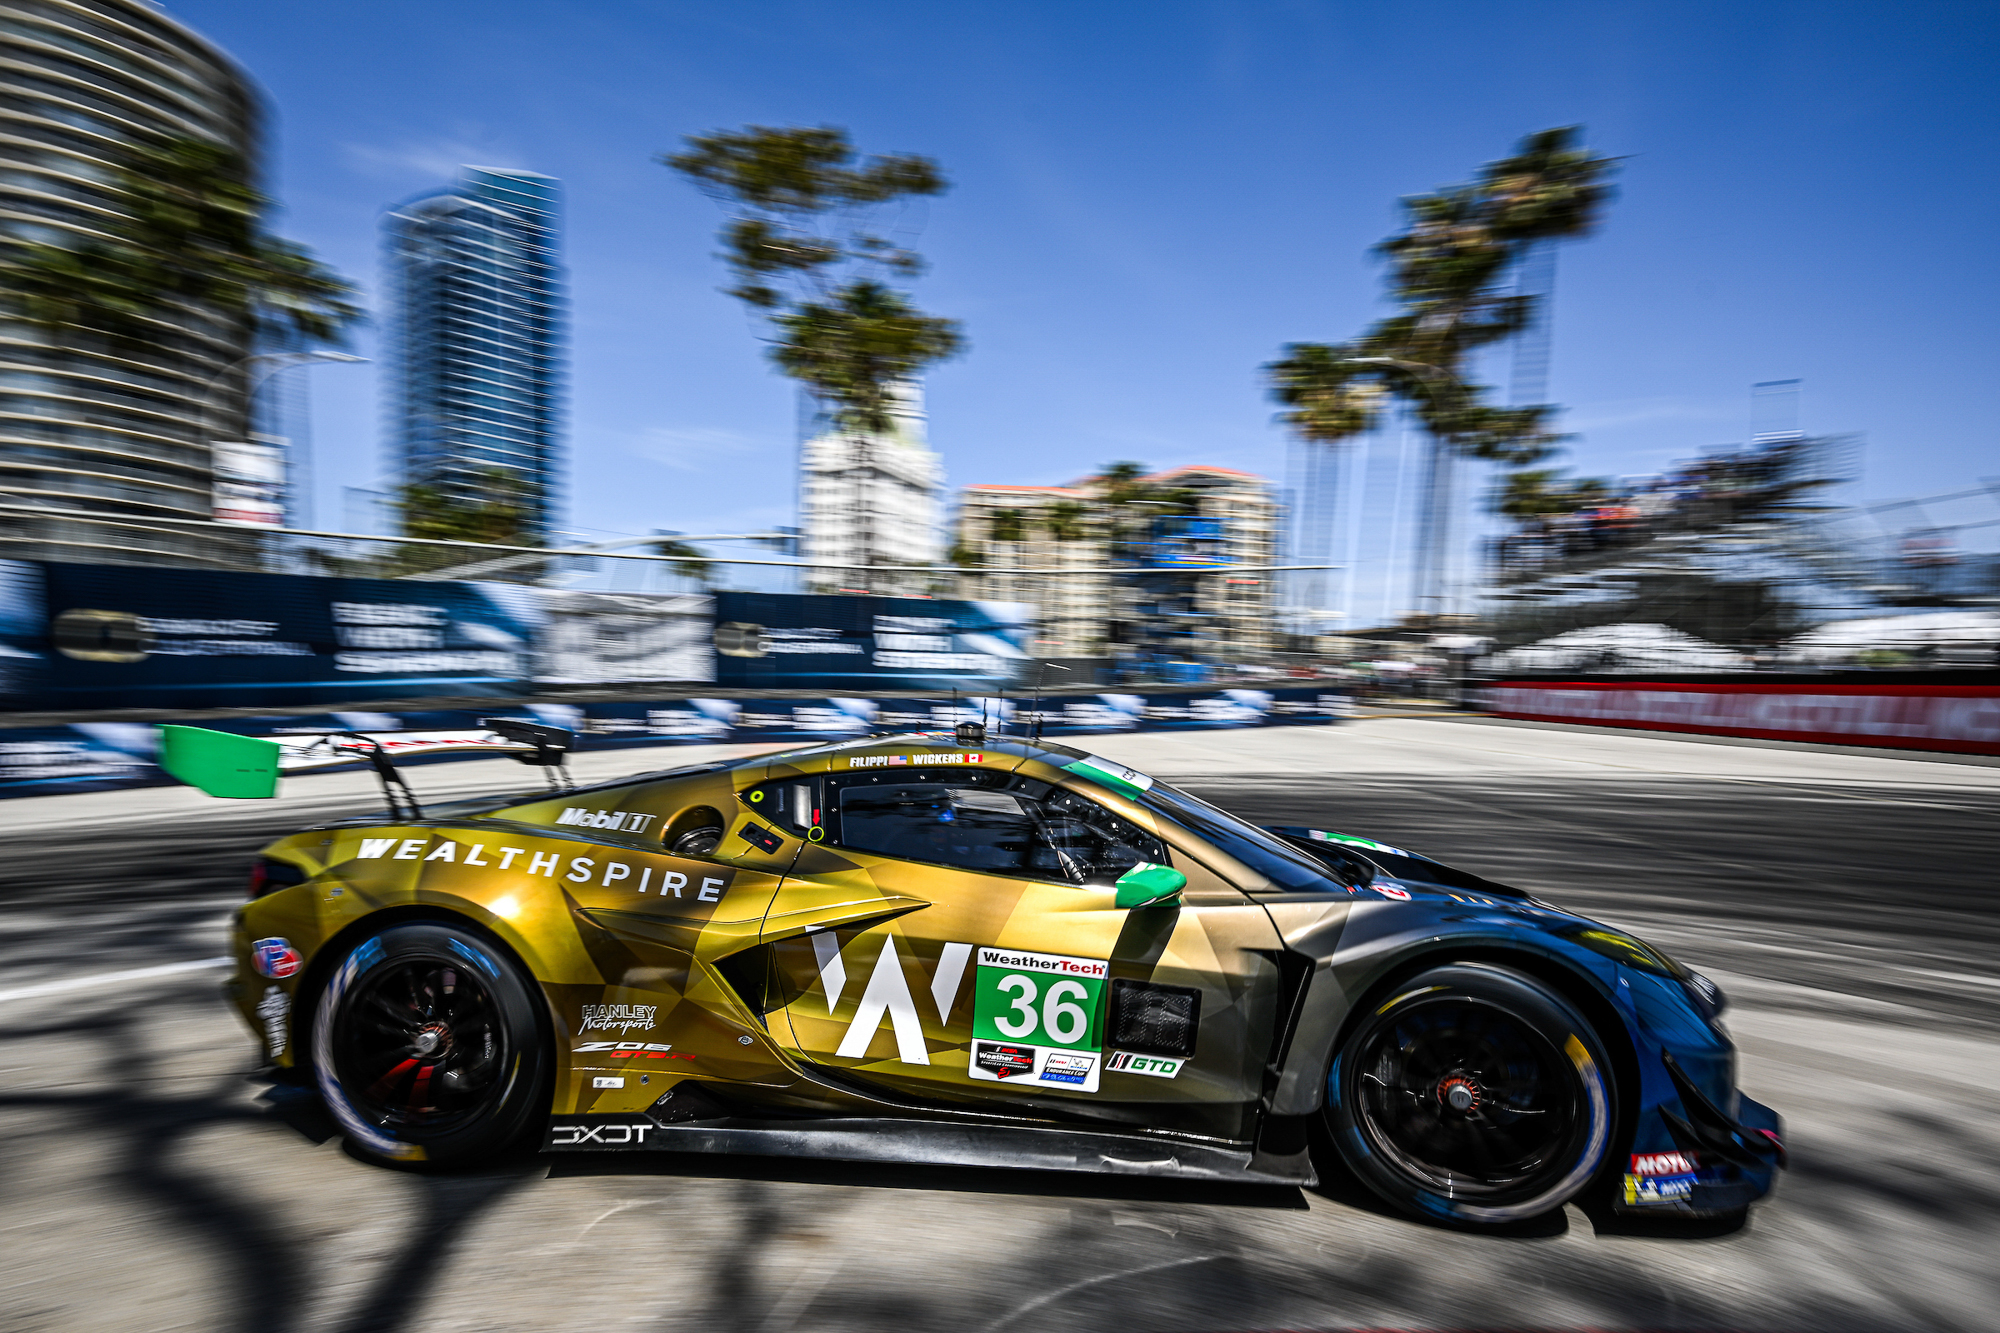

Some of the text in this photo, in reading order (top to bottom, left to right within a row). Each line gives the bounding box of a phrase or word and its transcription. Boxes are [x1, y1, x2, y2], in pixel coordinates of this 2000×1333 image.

[849, 753, 964, 768] FILIPPI WICKENS
[555, 807, 628, 831] Mobil
[356, 837, 725, 903] WEALTHSPIRE
[983, 951, 1104, 976] WeatherTech
[581, 1004, 658, 1019] HANLEY
[993, 973, 1090, 1045] 36
[577, 1014, 657, 1037] Motorsports
[571, 1040, 673, 1053] Z06
[978, 1051, 1034, 1065] WeatherTech
[1130, 1057, 1178, 1074] GTD
